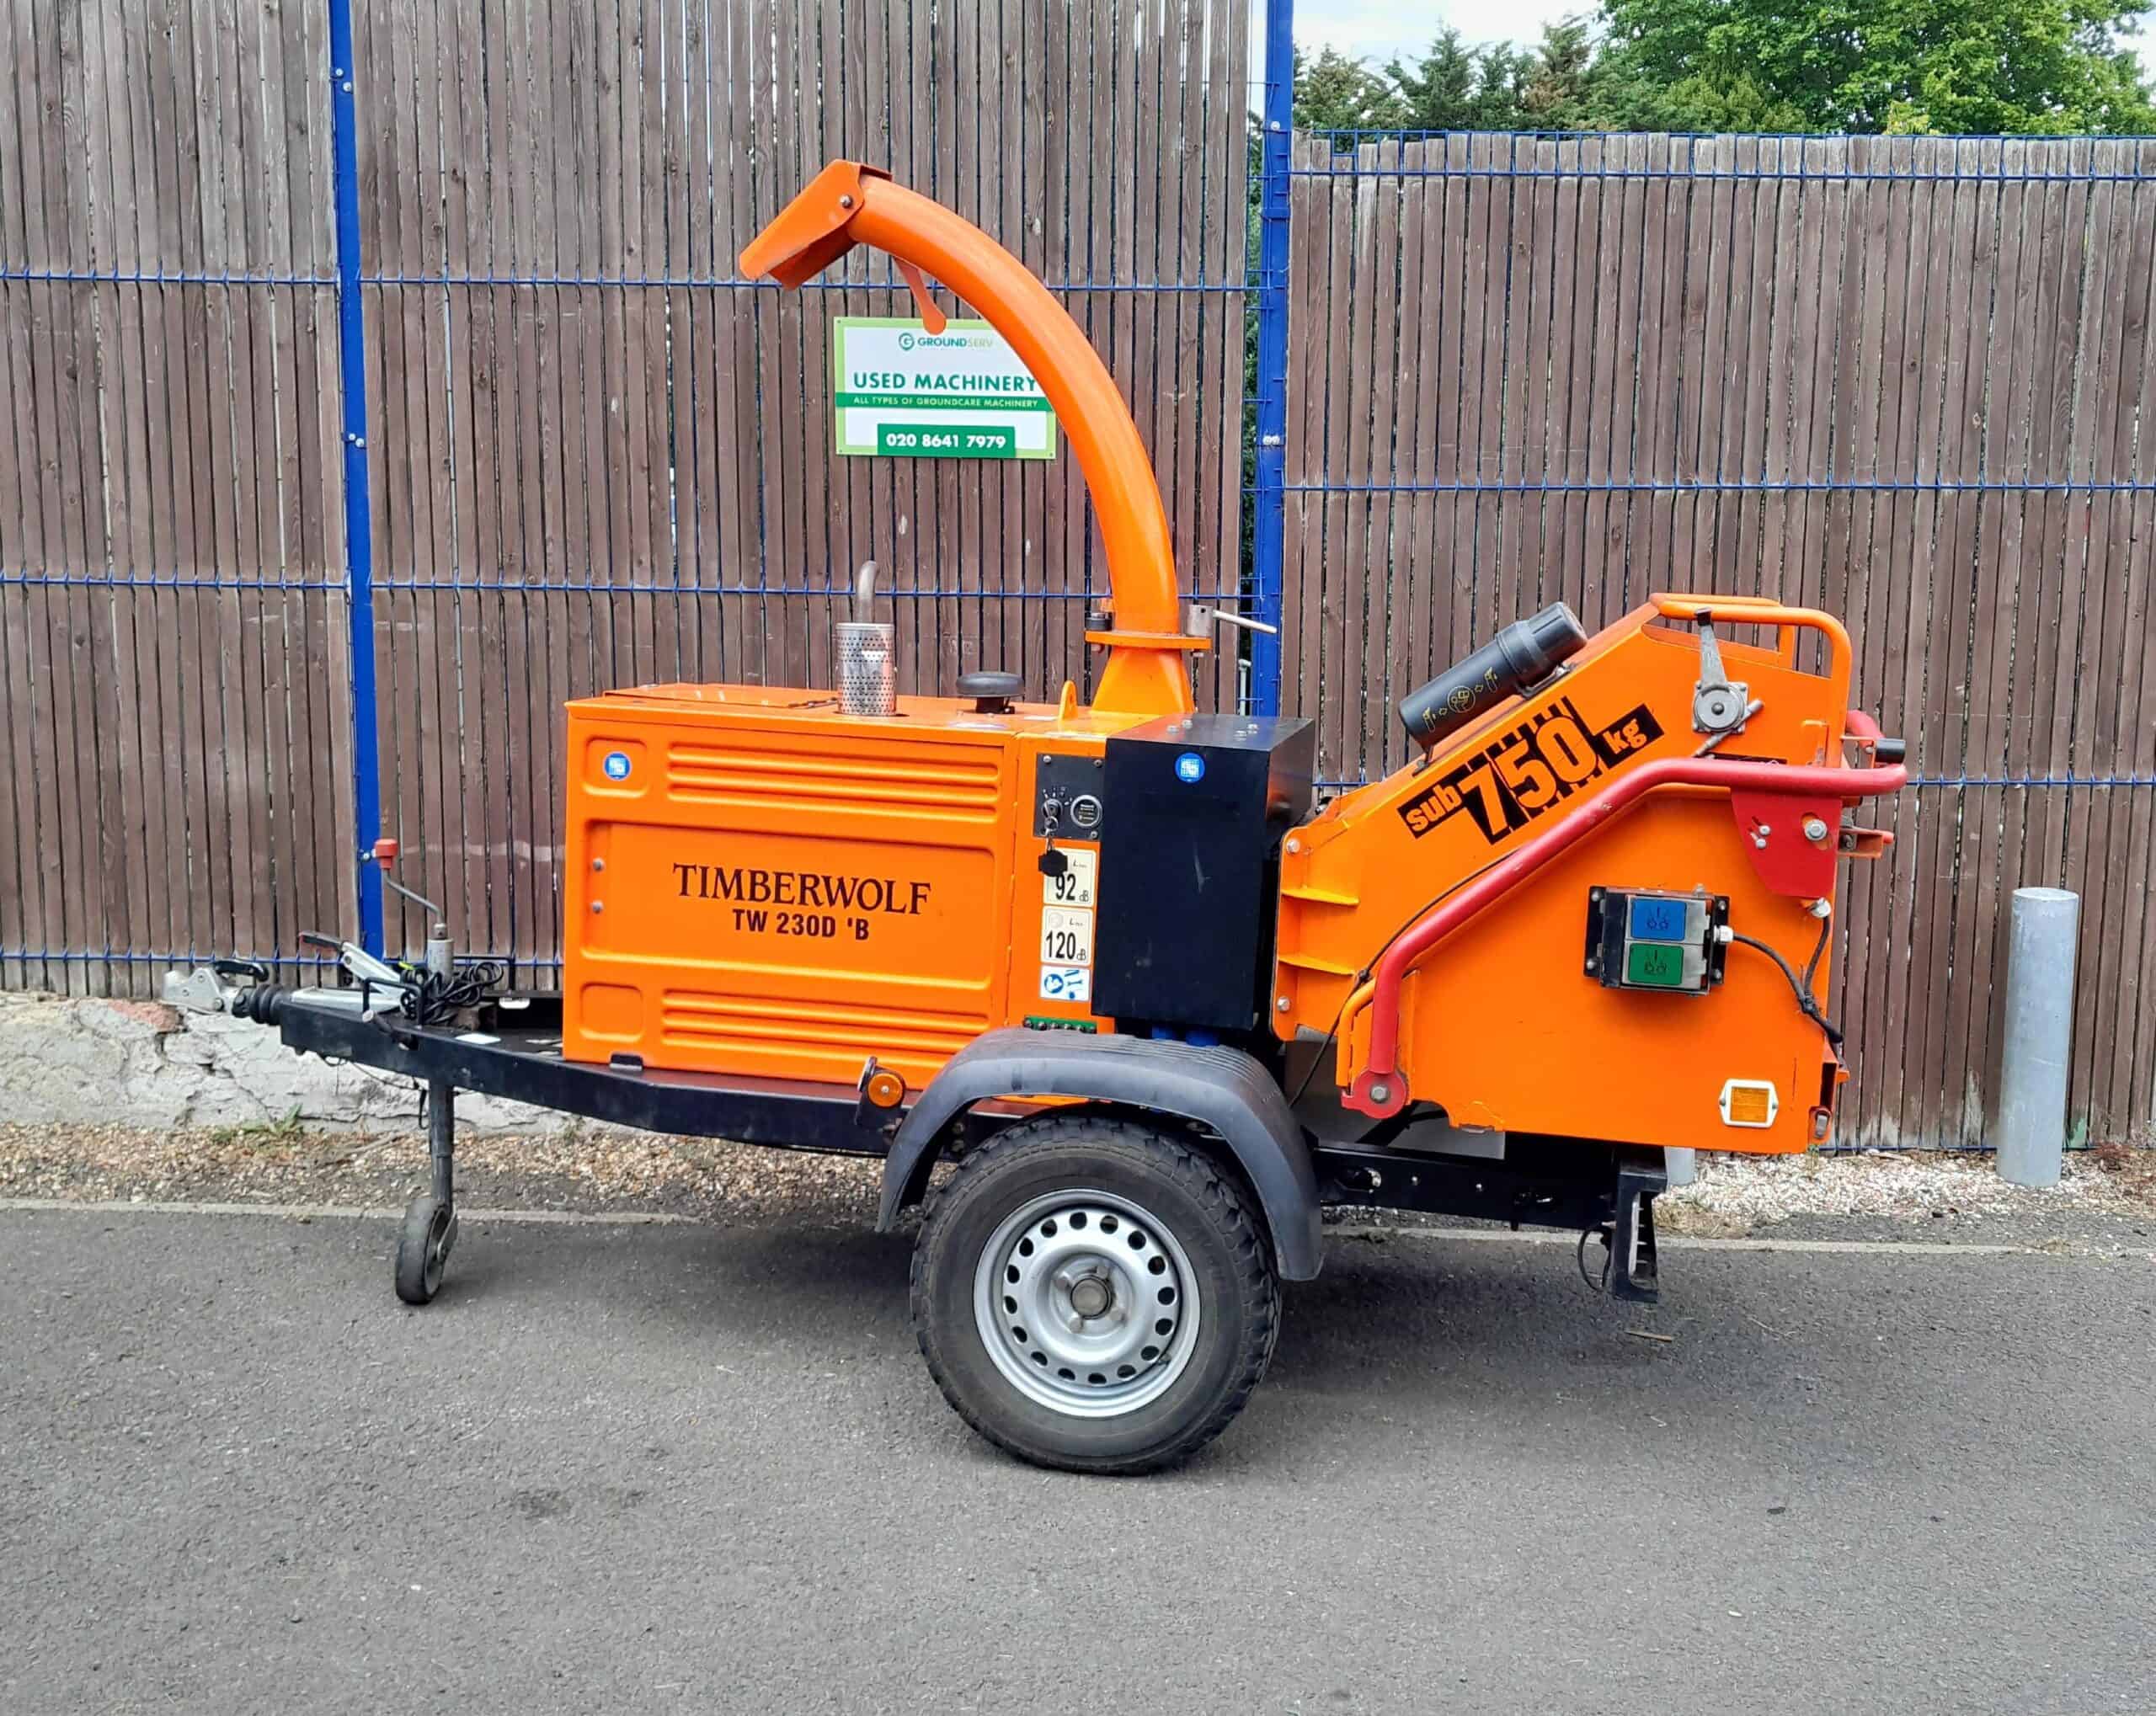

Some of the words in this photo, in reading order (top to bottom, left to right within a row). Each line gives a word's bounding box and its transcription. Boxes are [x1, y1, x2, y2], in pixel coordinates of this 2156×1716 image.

[853, 372, 906, 389] USED
[914, 374, 1037, 392] MACHINERY
[872, 397, 899, 405] TYPES
[916, 397, 981, 407] GROUNDCARE
[984, 399, 1038, 408] MACHINERY
[885, 433, 917, 447] 020
[922, 434, 959, 448] 8641
[966, 435, 1006, 449] 7979
[1406, 784, 1462, 832] sub
[1458, 715, 1598, 839] 750
[1603, 718, 1647, 755] kg
[674, 862, 931, 914] TIMBERWOLF
[1055, 873, 1076, 901] 92
[732, 908, 768, 932] TW
[776, 911, 836, 938] 230D
[1046, 930, 1076, 960] 120
